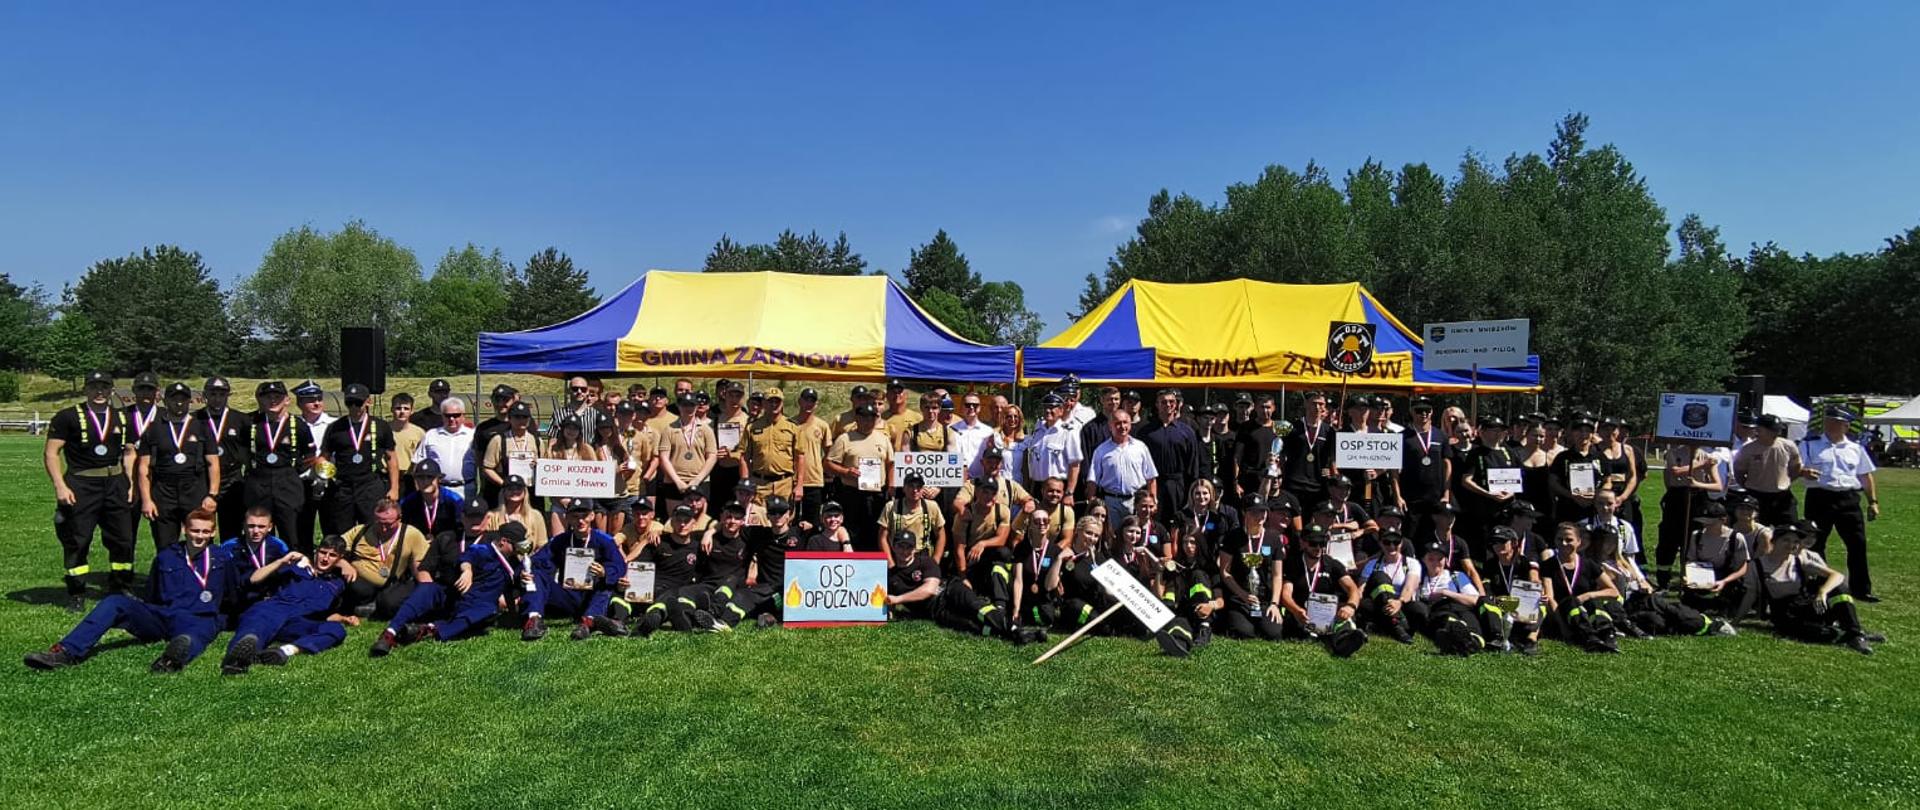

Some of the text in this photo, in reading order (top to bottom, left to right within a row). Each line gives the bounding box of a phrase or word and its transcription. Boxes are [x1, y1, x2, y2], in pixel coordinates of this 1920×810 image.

[641, 349, 728, 366] GMINA
[1169, 352, 1401, 379] GMINA ŻAW
[1340, 440, 1398, 451] OSP STOK
[916, 454, 943, 465] OSP
[543, 464, 562, 472] OSP
[541, 477, 570, 486] Gmina
[820, 564, 855, 588] OSP
[804, 588, 869, 609] OPOCZNO
